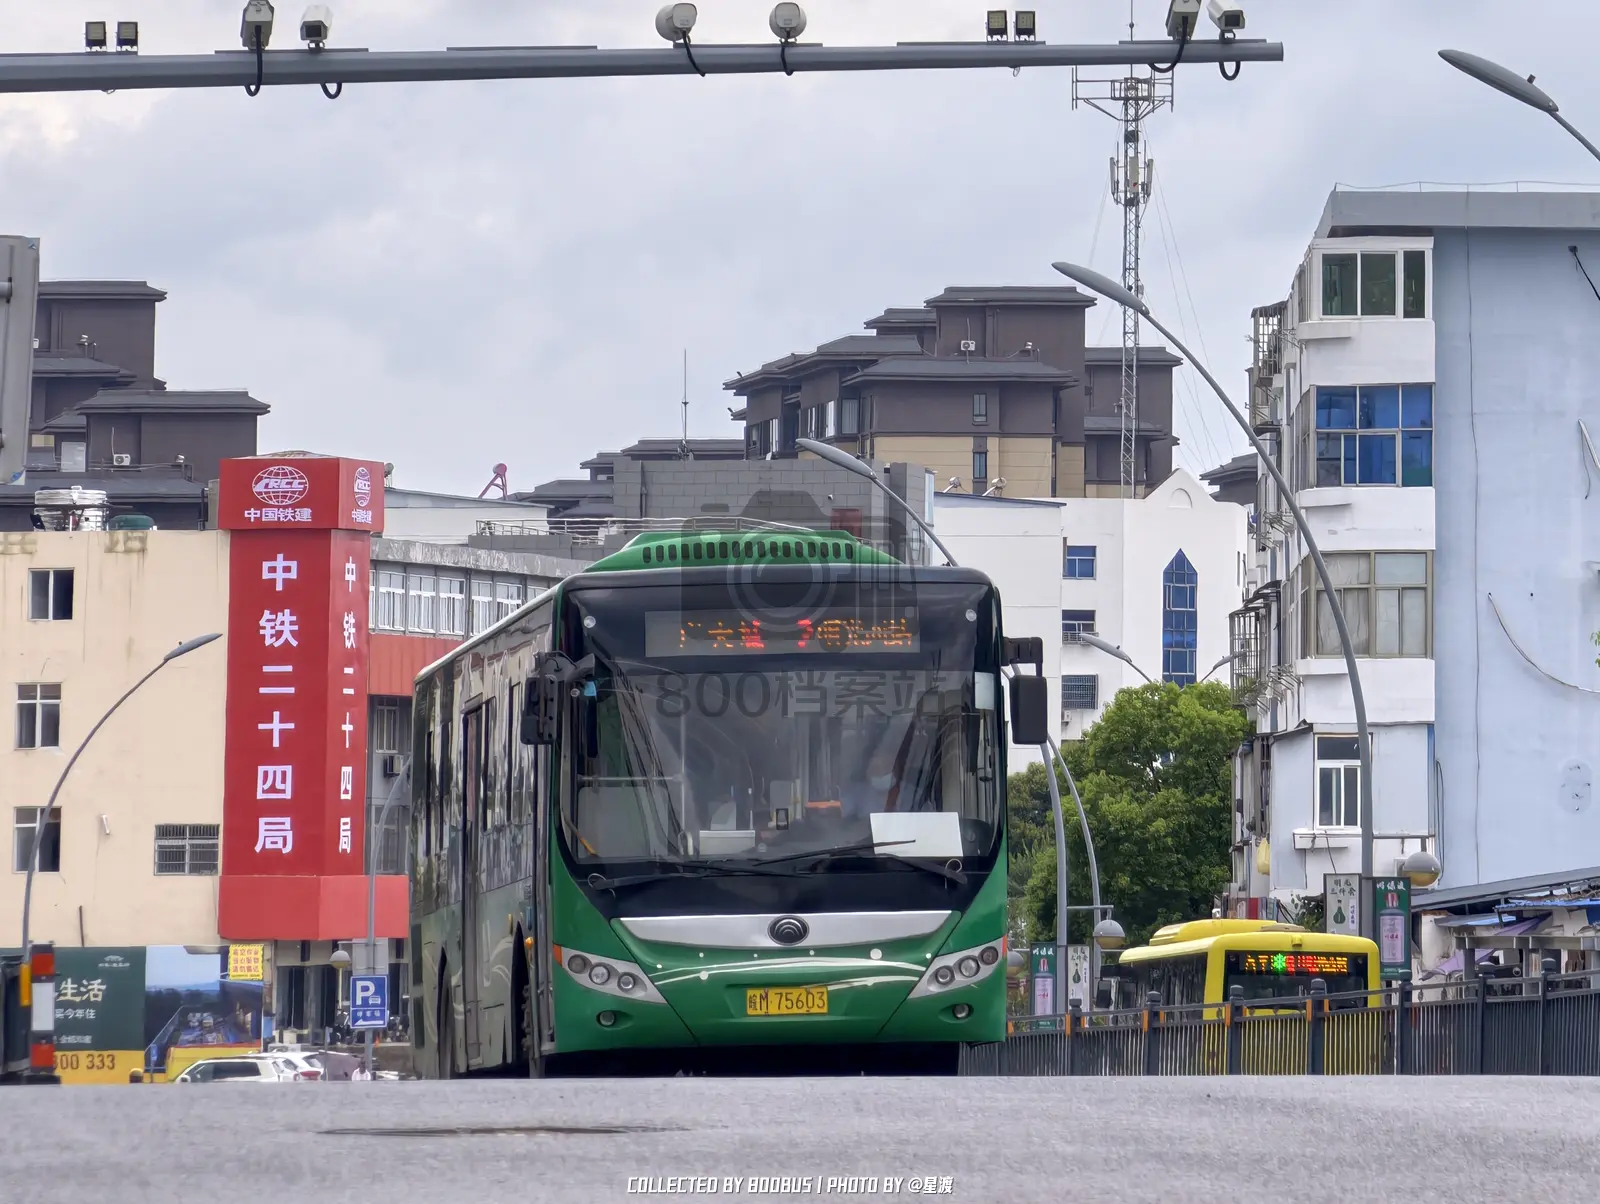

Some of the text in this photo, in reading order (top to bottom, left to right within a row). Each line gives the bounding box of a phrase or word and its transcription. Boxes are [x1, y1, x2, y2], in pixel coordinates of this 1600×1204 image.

[244, 507, 312, 522] 中国铁建
[254, 553, 299, 855] 中铁二十四局
[338, 555, 357, 856] 中铁二十四局
[54, 977, 107, 1002] 生活
[355, 980, 375, 1006] P
[86, 1053, 116, 1070] 333
